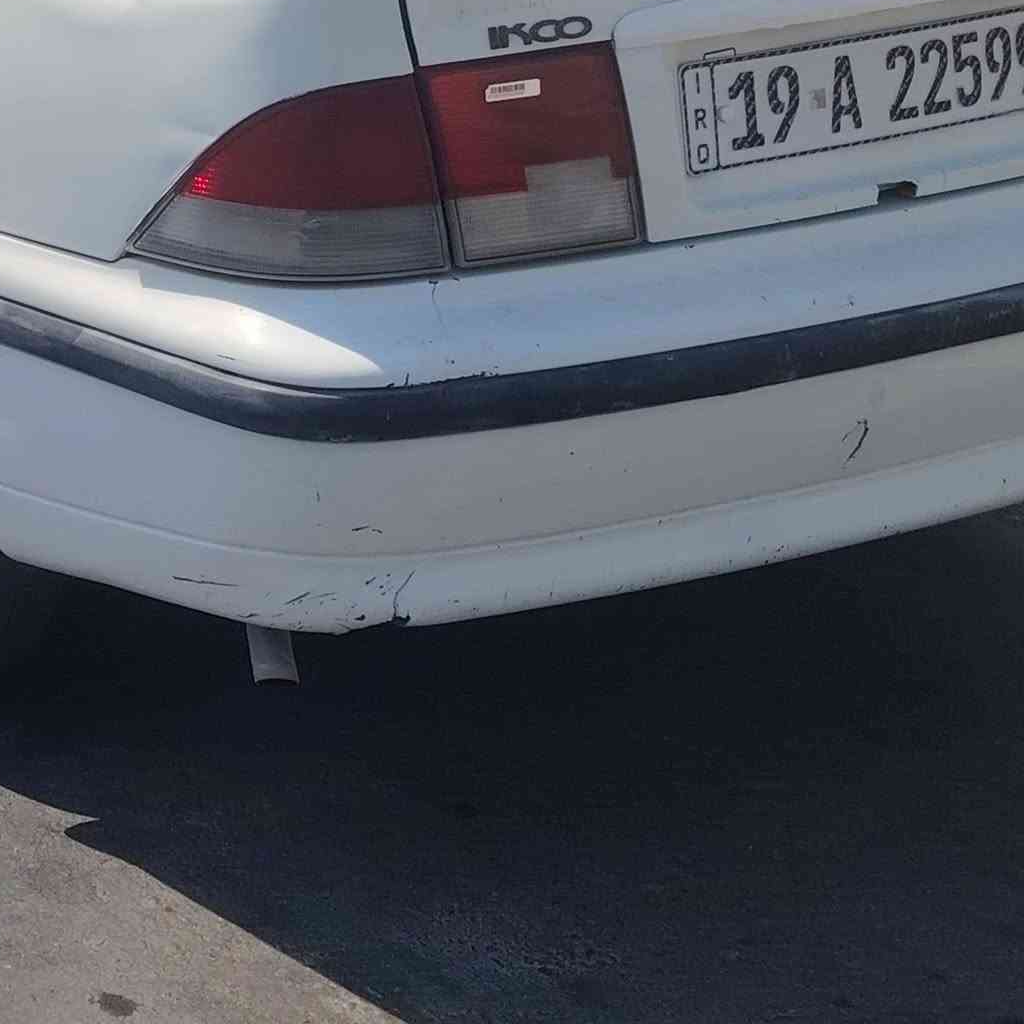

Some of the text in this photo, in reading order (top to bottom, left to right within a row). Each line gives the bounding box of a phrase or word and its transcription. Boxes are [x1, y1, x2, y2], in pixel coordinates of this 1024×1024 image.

[487, 16, 592, 50] IKCO
[728, 65, 800, 151] 19
[831, 55, 863, 133] A
